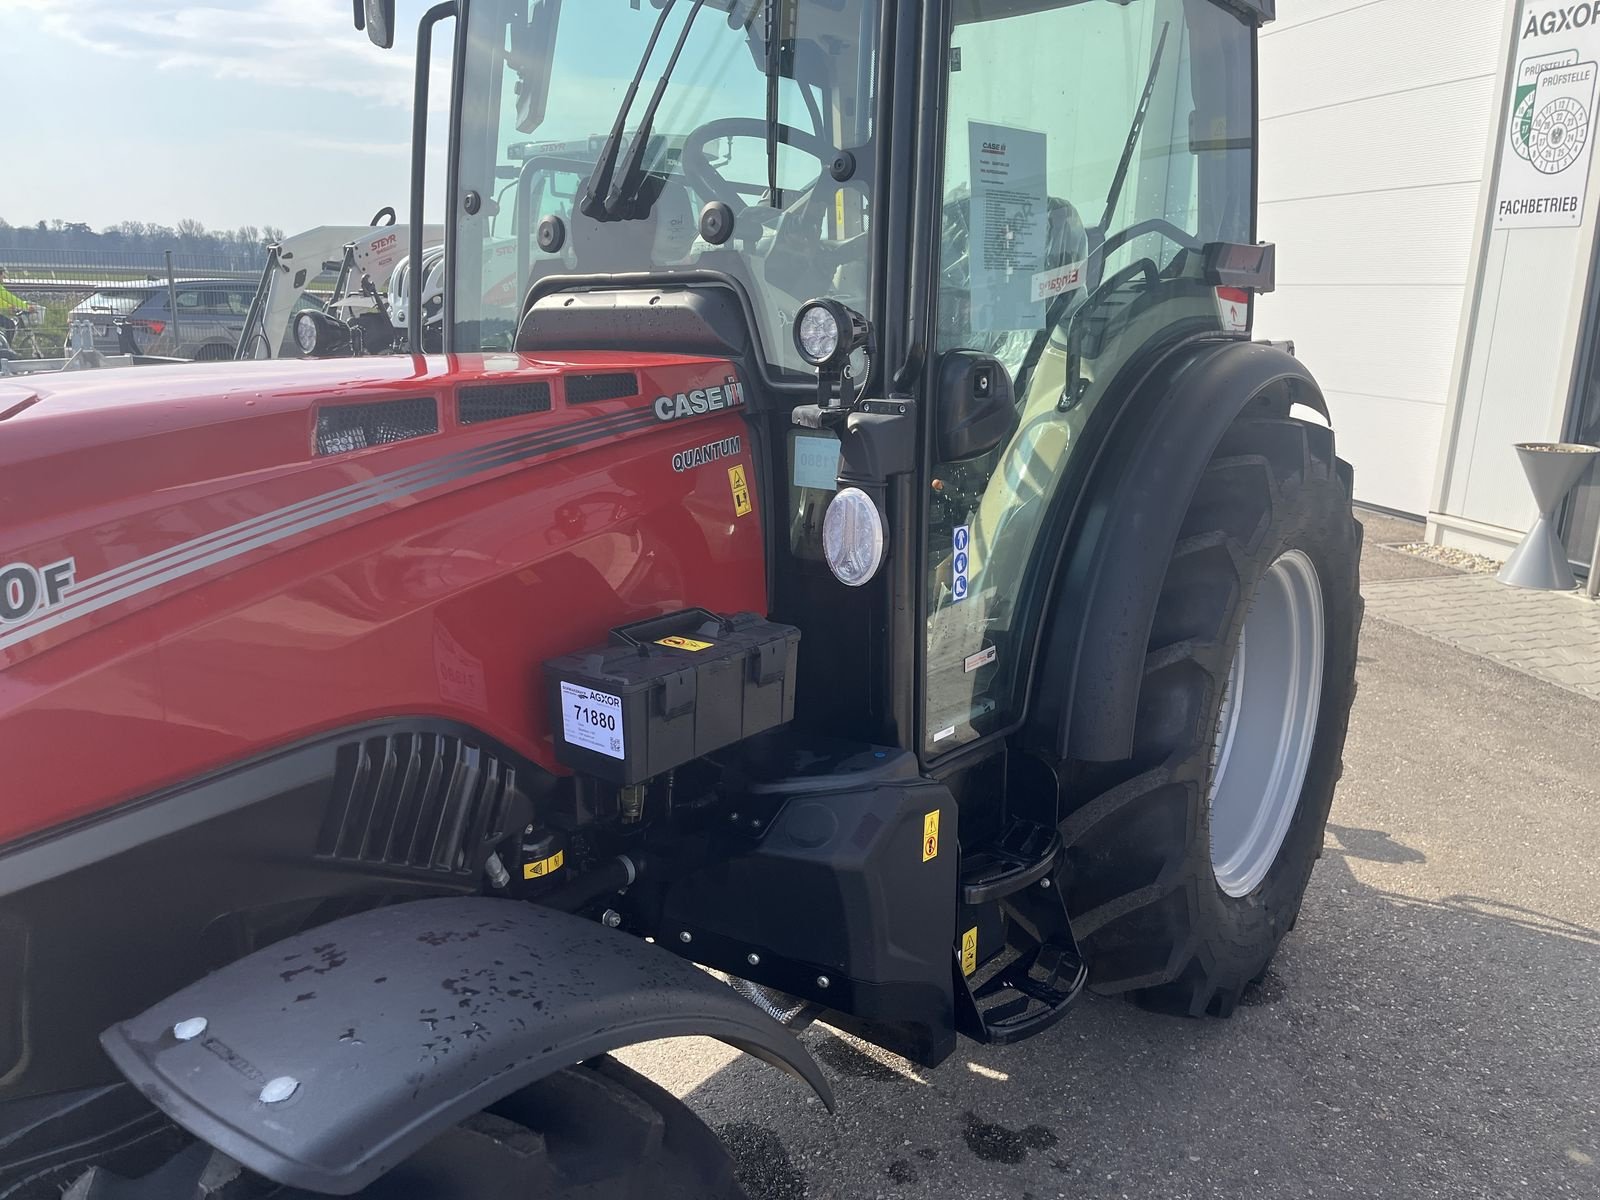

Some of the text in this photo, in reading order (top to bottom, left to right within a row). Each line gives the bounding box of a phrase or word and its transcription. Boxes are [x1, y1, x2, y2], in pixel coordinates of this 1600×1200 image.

[1542, 70, 1591, 87] PRÜFSTELLE
[1499, 196, 1578, 215] FACHBETRIEB
[371, 234, 397, 251] STEYR
[655, 386, 724, 420] CASE
[672, 435, 741, 472] QUANTUM
[589, 691, 620, 708] AGXOR
[574, 704, 616, 731] 71880
